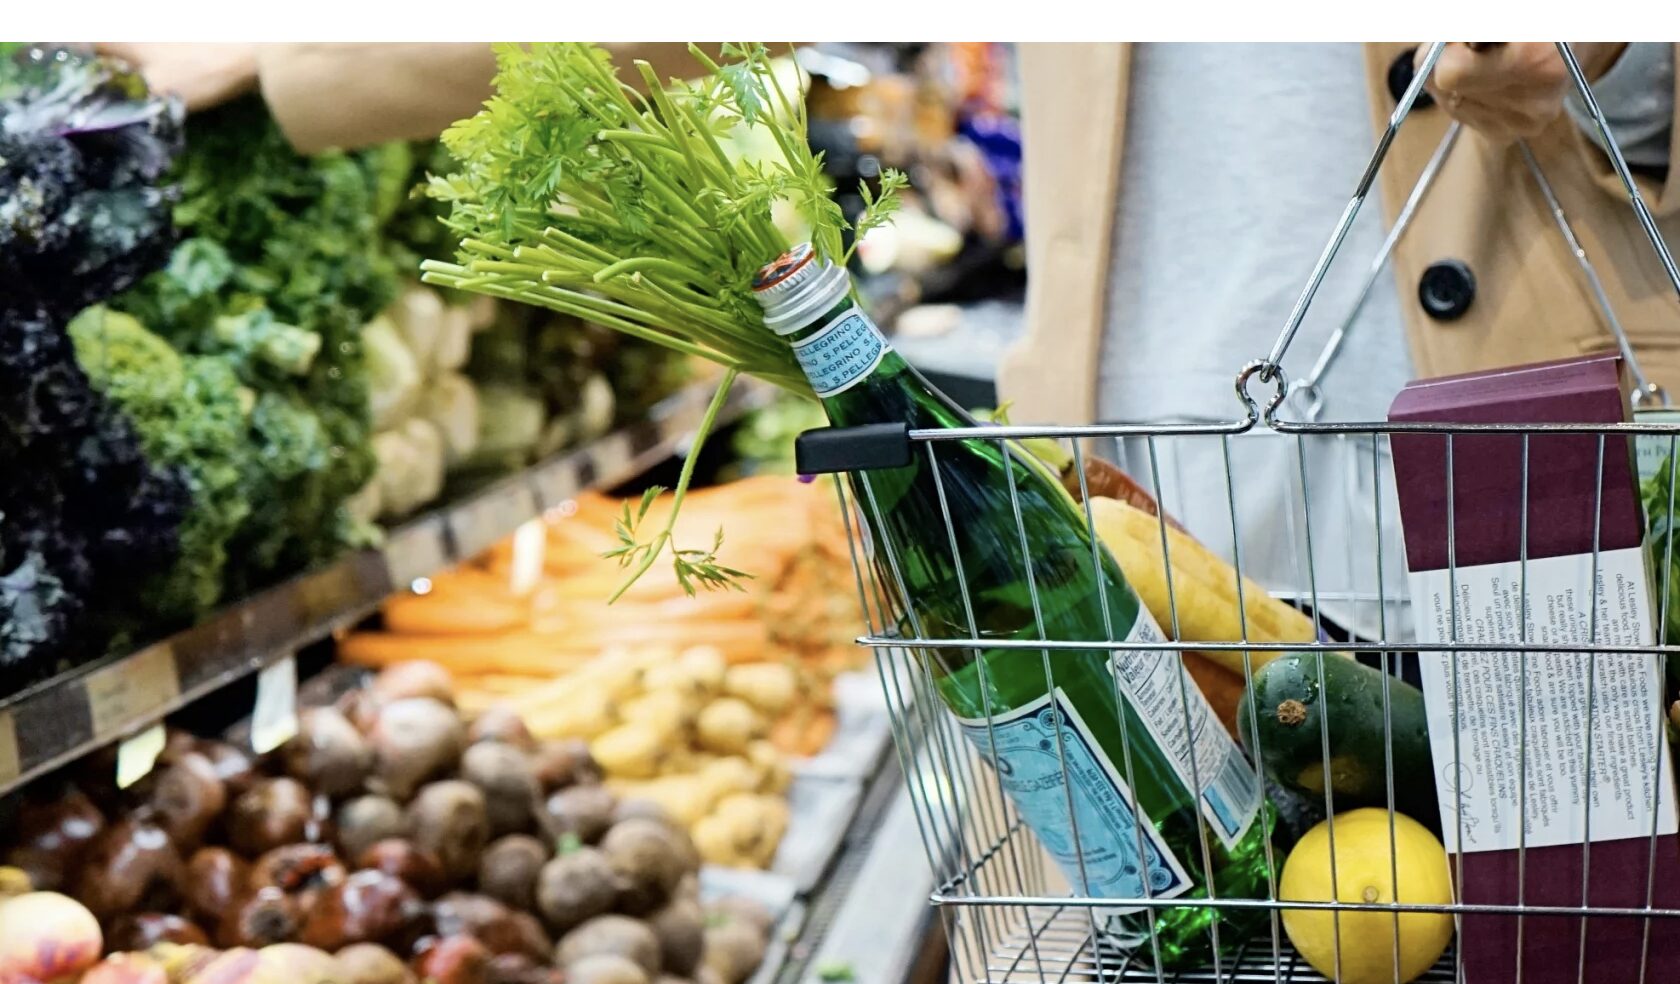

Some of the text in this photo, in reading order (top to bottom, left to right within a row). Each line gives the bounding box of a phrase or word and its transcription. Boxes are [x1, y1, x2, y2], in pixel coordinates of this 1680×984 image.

[1491, 577, 1500, 596] Seul
[1511, 581, 1519, 592] de
[1616, 573, 1627, 609] delicious
[1626, 580, 1634, 590] At
[1433, 592, 1441, 612] vous
[1494, 598, 1501, 608] un
[1547, 594, 1557, 625] cheese
[1556, 594, 1564, 607] but
[1565, 588, 1575, 611] these
[1626, 592, 1638, 619] Lesley
[1436, 614, 1443, 625] ne
[1556, 609, 1568, 631] really
[1601, 607, 1609, 620] her
[1466, 624, 1473, 634] au
[1494, 610, 1506, 639] produit
[1526, 622, 1536, 643] Stow
[1567, 614, 1579, 642] unique
[1580, 620, 1589, 643] CRIS
[1603, 624, 1612, 644] team
[1441, 660, 1451, 677] plus
[1462, 659, 1470, 669] de
[1491, 651, 1502, 681] pouvait
[1565, 658, 1574, 680] when
[1636, 654, 1644, 670] ine
[1472, 669, 1480, 684] ces
[1482, 666, 1492, 693] POUR
[1533, 670, 1543, 696] Foods
[1598, 658, 1608, 689] scratch
[1609, 669, 1617, 682] the
[1627, 662, 1638, 697] fabulous
[1638, 671, 1648, 697] Foods
[1502, 589, 1510, 608] avec
[1508, 633, 1515, 643] en
[1528, 780, 1536, 790] de
[1502, 673, 1515, 706] fabriqué
[1558, 679, 1566, 693] We
[1609, 684, 1620, 702] only
[1617, 660, 1626, 677] with
[1623, 709, 1633, 731] small
[1473, 686, 1487, 728] craquelins
[1486, 695, 1495, 714] CES
[1496, 683, 1508, 720] satisfaire
[1526, 688, 1537, 722] fabuleux
[1550, 697, 1558, 715] sure
[1566, 683, 1578, 711] topped
[1600, 690, 1611, 713] using
[1642, 699, 1648, 711] we
[1469, 715, 1478, 726] de
[1509, 709, 1517, 728] avec
[1536, 698, 1546, 722] adore
[1611, 704, 1620, 720] way
[1630, 699, 1641, 723] crisps
[1489, 716, 1498, 737] FINS
[1551, 717, 1560, 732] you
[1562, 710, 1573, 746] addicted
[1572, 713, 1581, 729] with
[1616, 722, 1623, 731] to
[1643, 713, 1652, 730] love
[1470, 728, 1482, 762] fromage
[1481, 730, 1489, 747] sont
[1500, 722, 1512, 749] Lesley
[1512, 730, 1520, 745] des
[1538, 724, 1551, 760] fabriquer
[1555, 734, 1564, 747] will
[1573, 732, 1582, 749] your
[1607, 730, 1616, 752] finest
[1617, 733, 1626, 755] make
[1635, 725, 1644, 744] from
[1529, 724, 1543, 767] craquelins
[1557, 749, 1565, 759] be
[1644, 732, 1656, 763] making
[1476, 764, 1483, 774] ou
[1492, 739, 1506, 798] CRAQUELINS
[1568, 758, 1577, 773] this
[1636, 747, 1649, 779] Lesley's
[1537, 769, 1545, 786] sont
[1546, 773, 1554, 792] vous
[1619, 765, 1630, 786] great
[1569, 775, 1579, 804] yummy
[1592, 790, 1600, 807] own
[1643, 782, 1653, 812] kitchen
[1538, 789, 1551, 826] fabriqués
[1549, 794, 1558, 813] offrir
[1622, 788, 1635, 820] product
